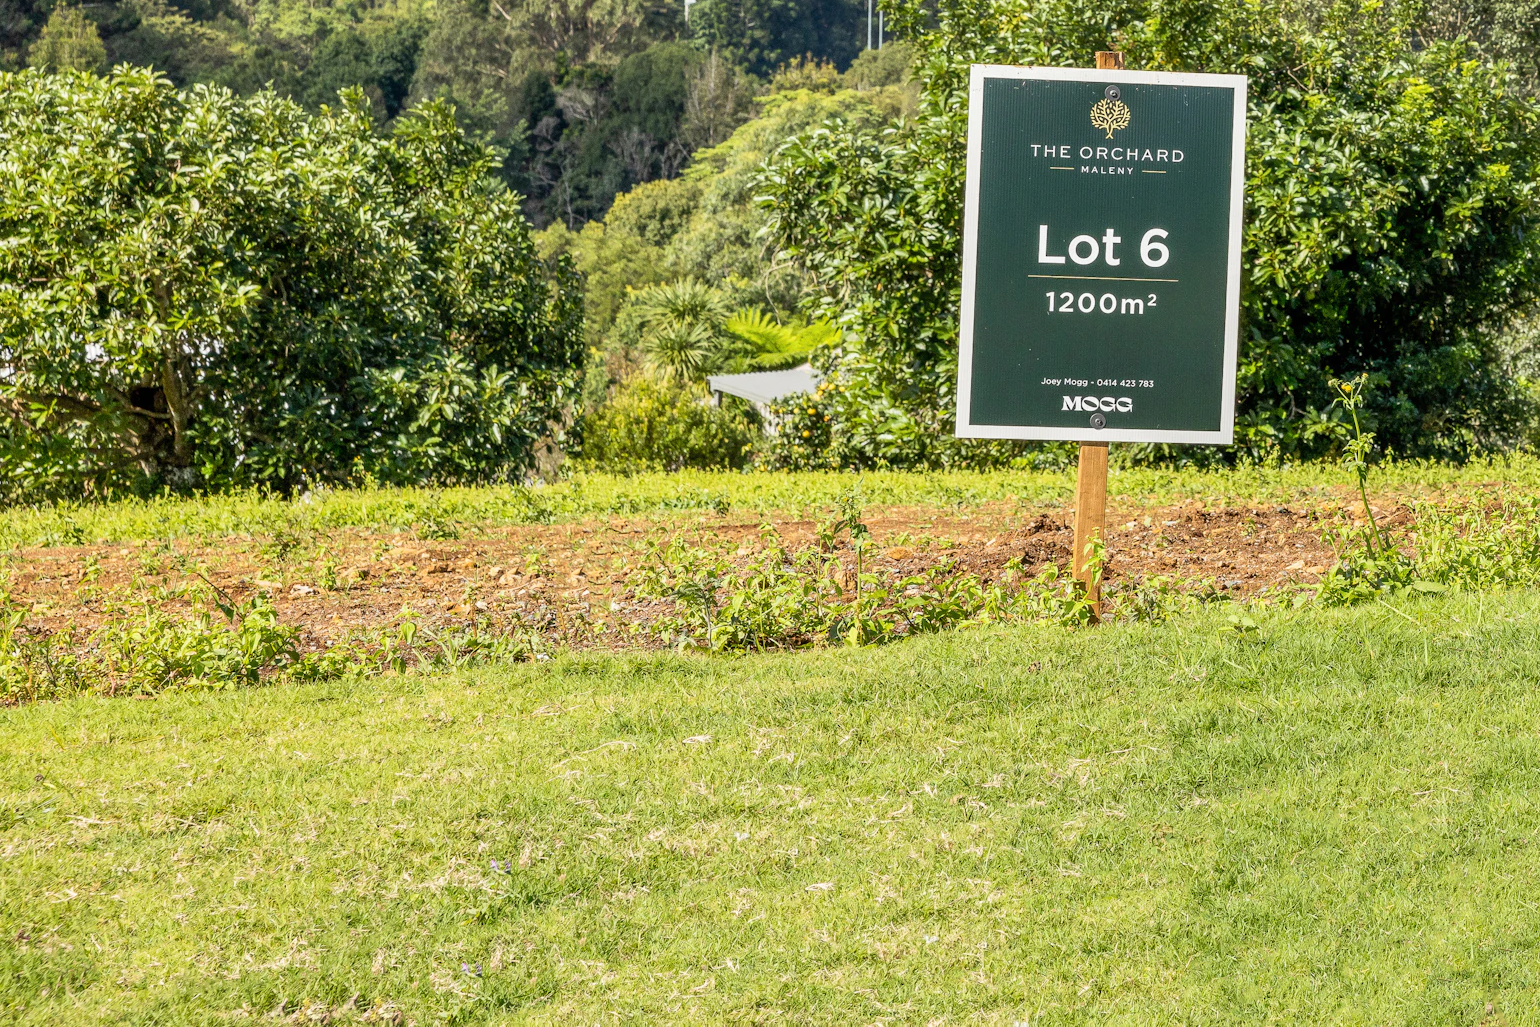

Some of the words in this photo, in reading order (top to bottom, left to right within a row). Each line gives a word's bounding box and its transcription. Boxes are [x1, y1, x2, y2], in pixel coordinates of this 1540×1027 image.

[1031, 144, 1072, 159] THE
[1080, 146, 1184, 163] ORCHARD
[1081, 165, 1134, 175] MALENY
[1037, 224, 1122, 267] Lot
[1139, 227, 1170, 268] 6
[1040, 377, 1062, 387] Joey
[1063, 377, 1088, 388] Mogg
[1097, 378, 1118, 387] 0414
[1120, 378, 1136, 387] 423
[1138, 379, 1154, 387] 783
[1061, 395, 1134, 413] MOGG
